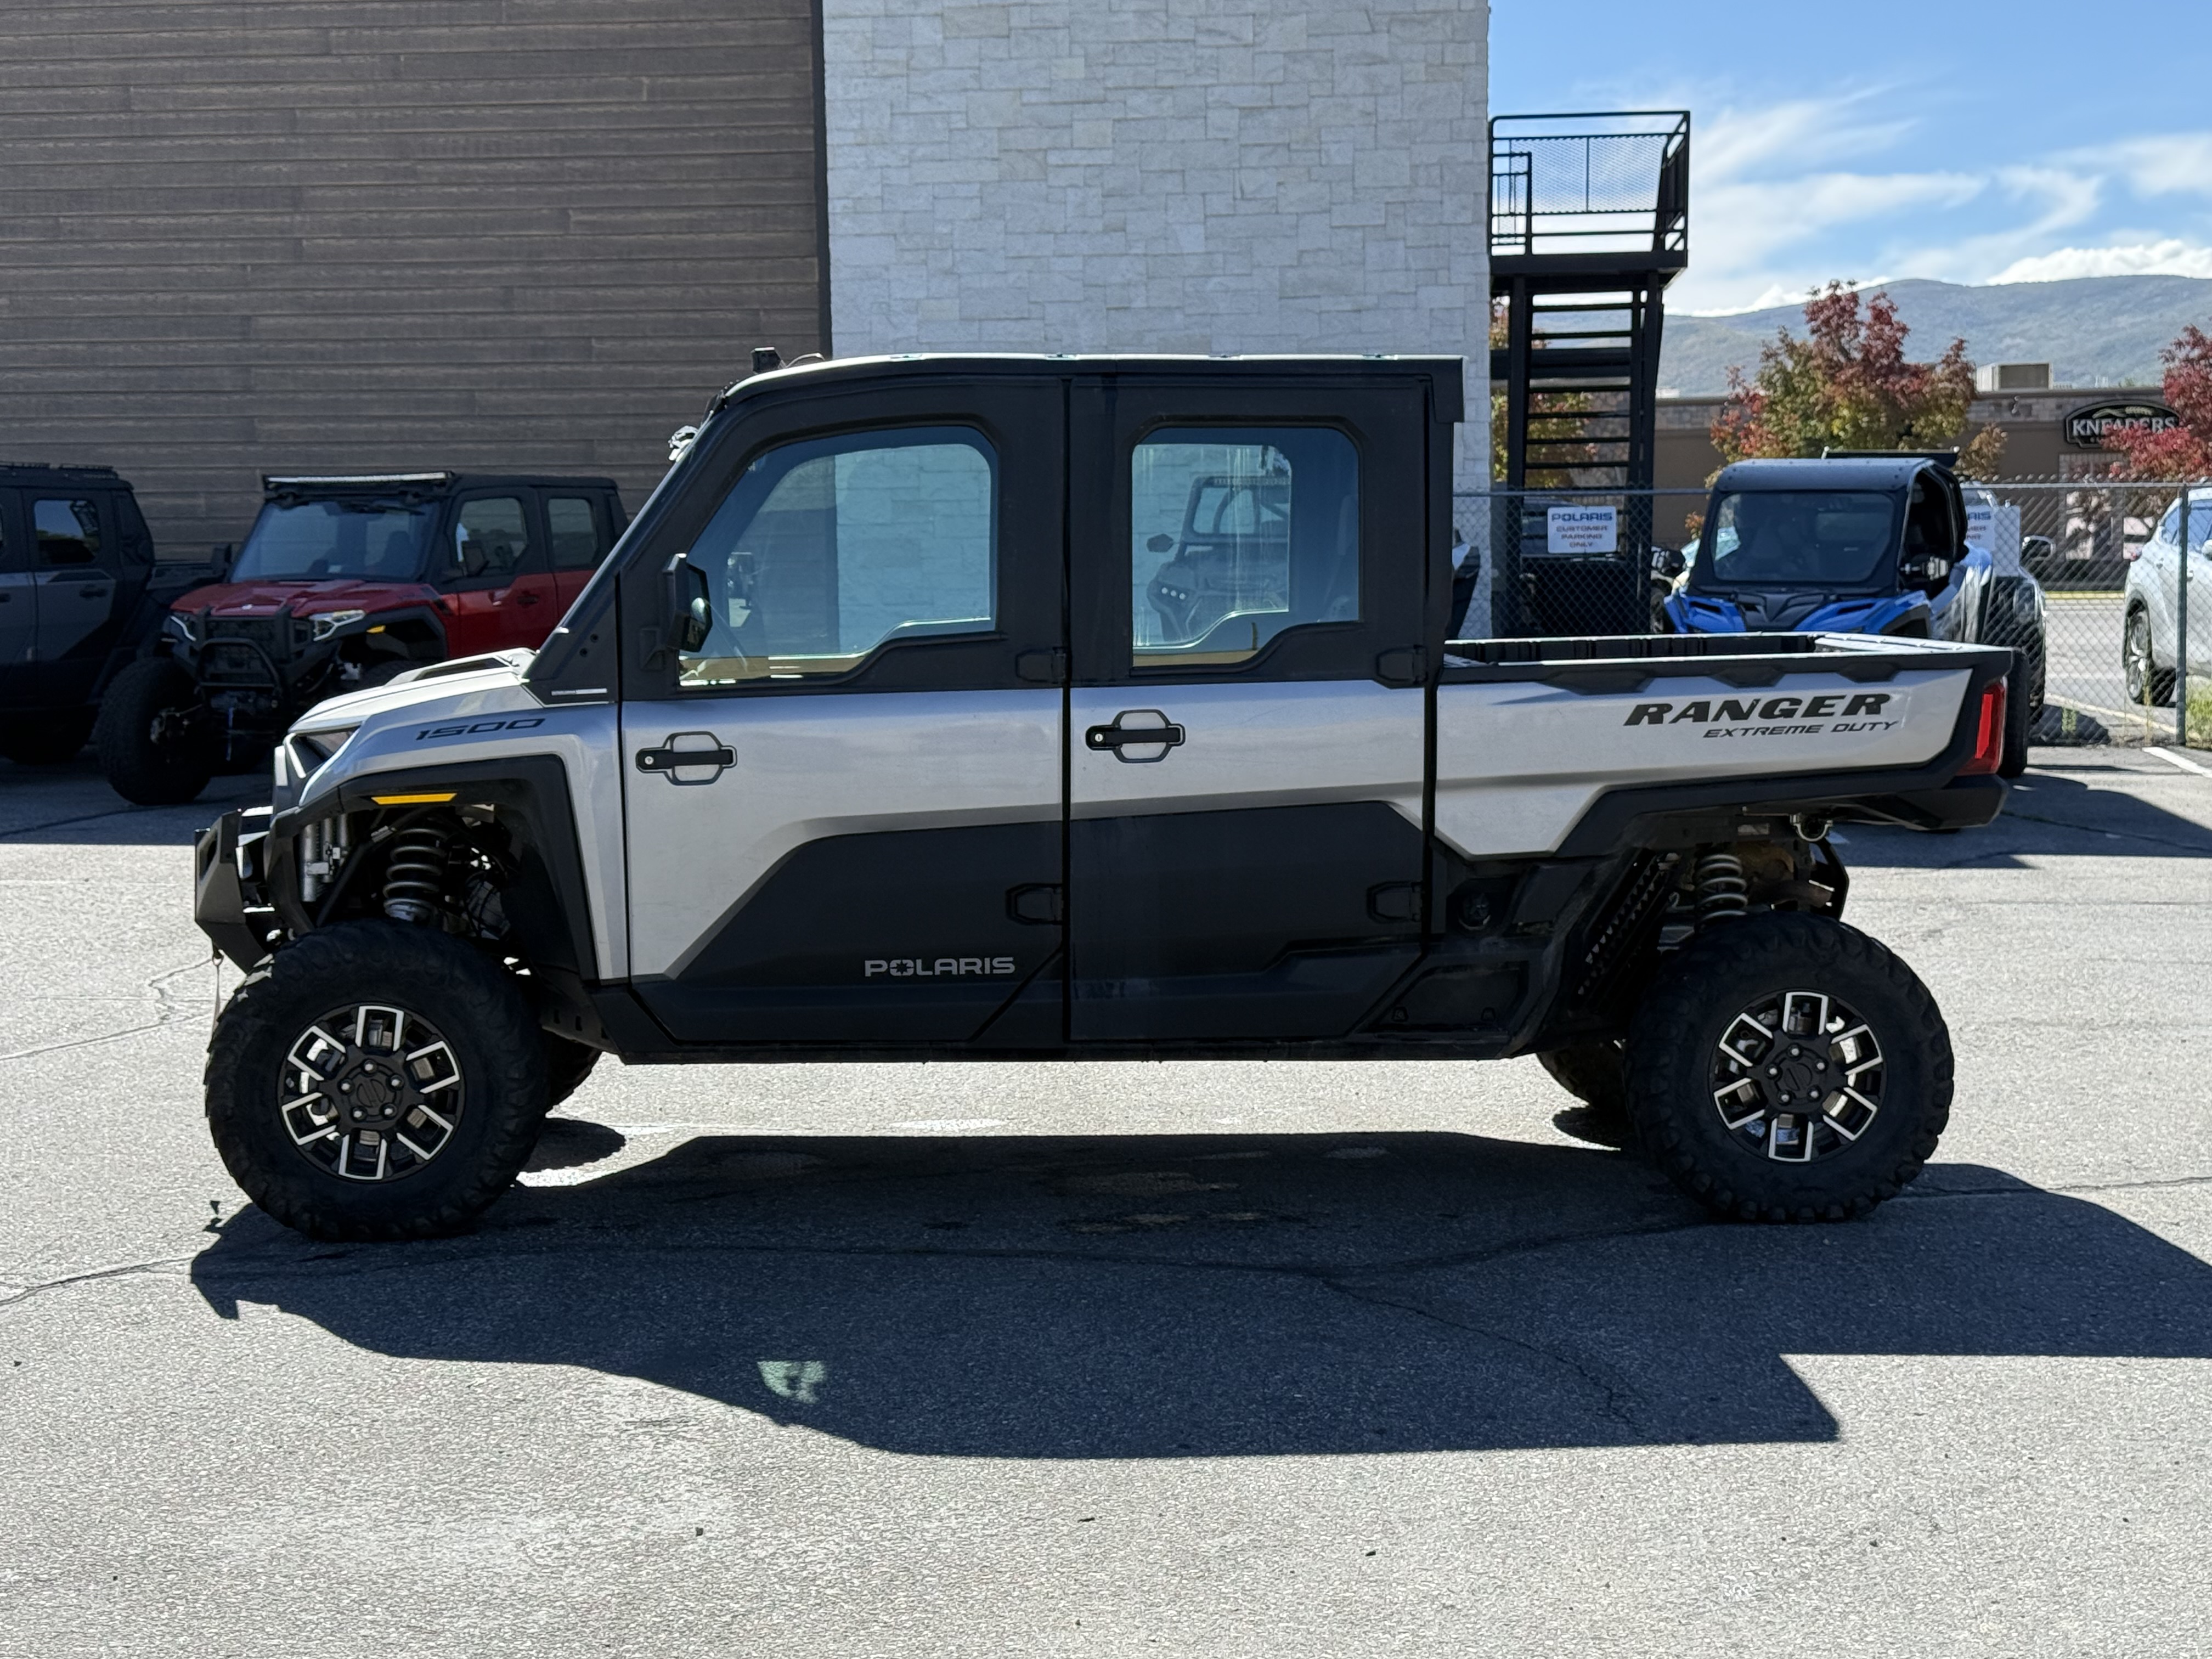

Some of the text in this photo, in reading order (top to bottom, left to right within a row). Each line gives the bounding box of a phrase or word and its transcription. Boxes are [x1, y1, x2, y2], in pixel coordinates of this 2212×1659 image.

[1551, 512, 1613, 522] POLARIS
[1623, 693, 1893, 727] RANGER
[415, 718, 546, 741] 1500
[1702, 720, 1900, 738] EXTREME DUTY
[865, 957, 1015, 977] POLARIS
